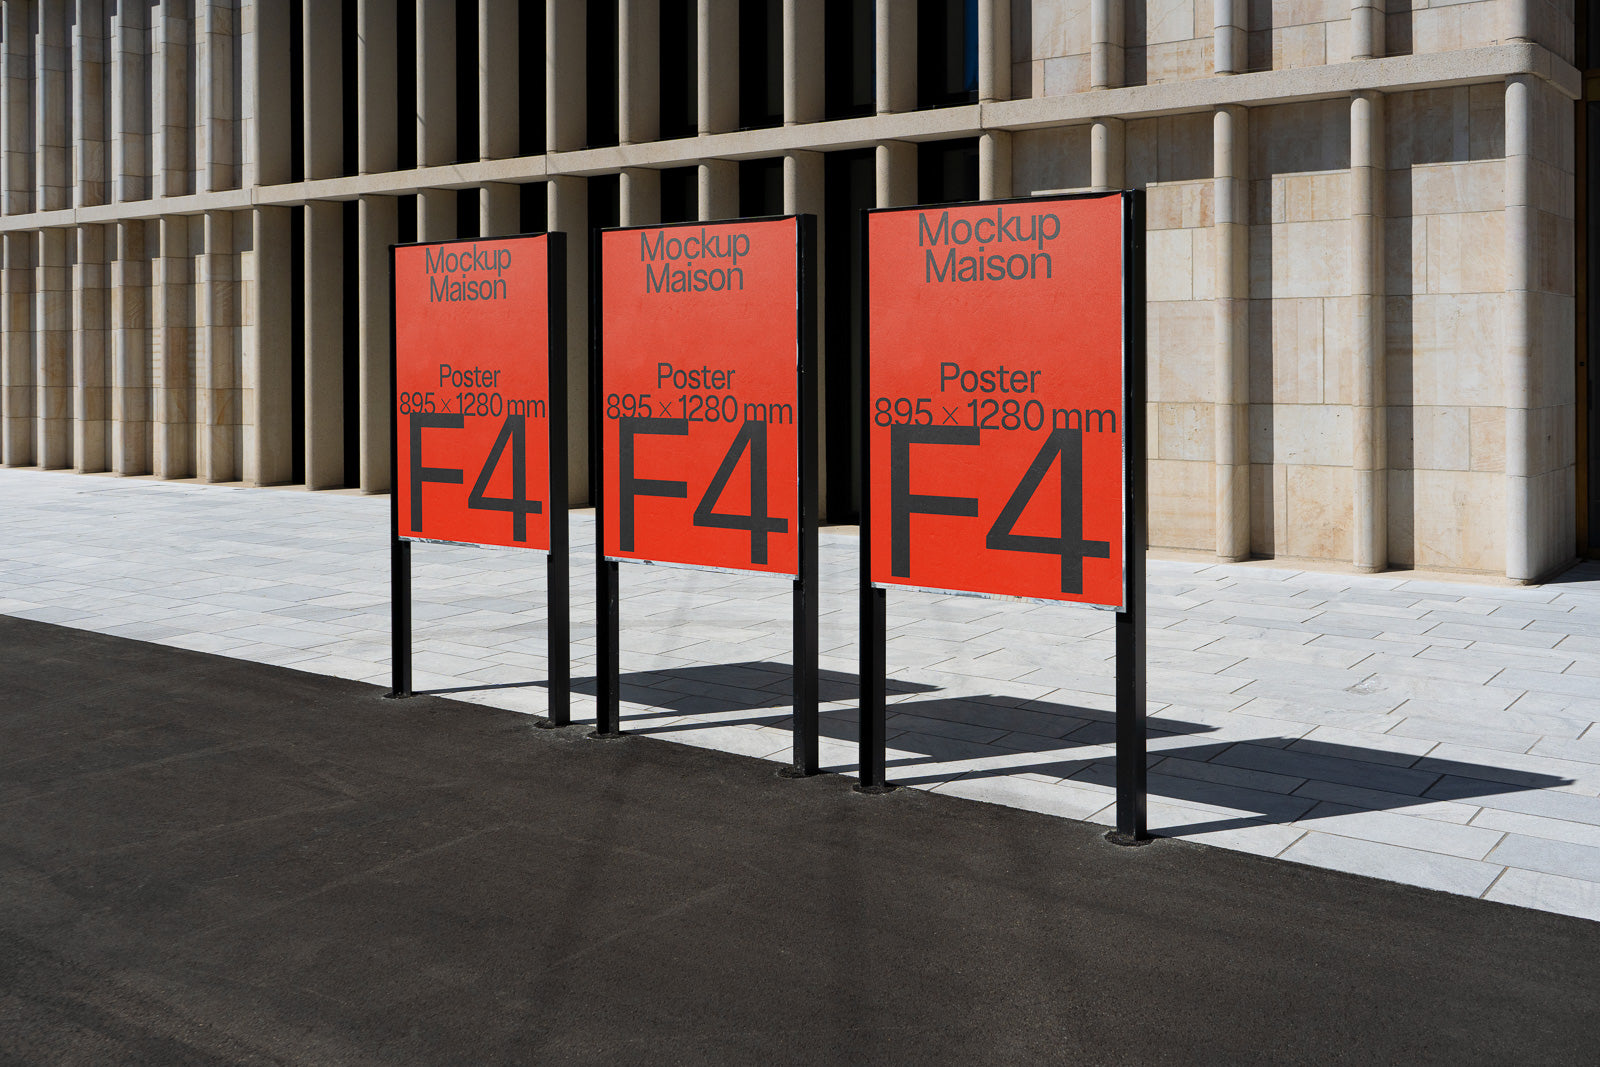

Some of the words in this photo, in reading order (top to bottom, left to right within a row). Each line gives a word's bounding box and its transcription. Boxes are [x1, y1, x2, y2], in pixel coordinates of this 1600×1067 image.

[640, 227, 751, 266] Mockup
[918, 207, 1061, 251] Mockup
[425, 243, 512, 278] Mockup
[646, 261, 744, 294] Maison
[925, 246, 1052, 284] Maison
[430, 274, 507, 302] Maison
[439, 363, 501, 388] Poster
[657, 362, 736, 390] Poster
[940, 361, 1042, 394] Poster
[399, 391, 436, 415] 895
[456, 392, 503, 418] 1280
[507, 398, 546, 419] mm
[606, 392, 653, 420] 895
[678, 394, 739, 424] 1280
[743, 403, 793, 425] mm
[874, 396, 933, 426] 895
[967, 398, 1045, 432] 1280
[1052, 408, 1117, 434] mm
[409, 412, 543, 543] F4
[619, 417, 789, 566] F4
[890, 423, 1111, 595] F4
